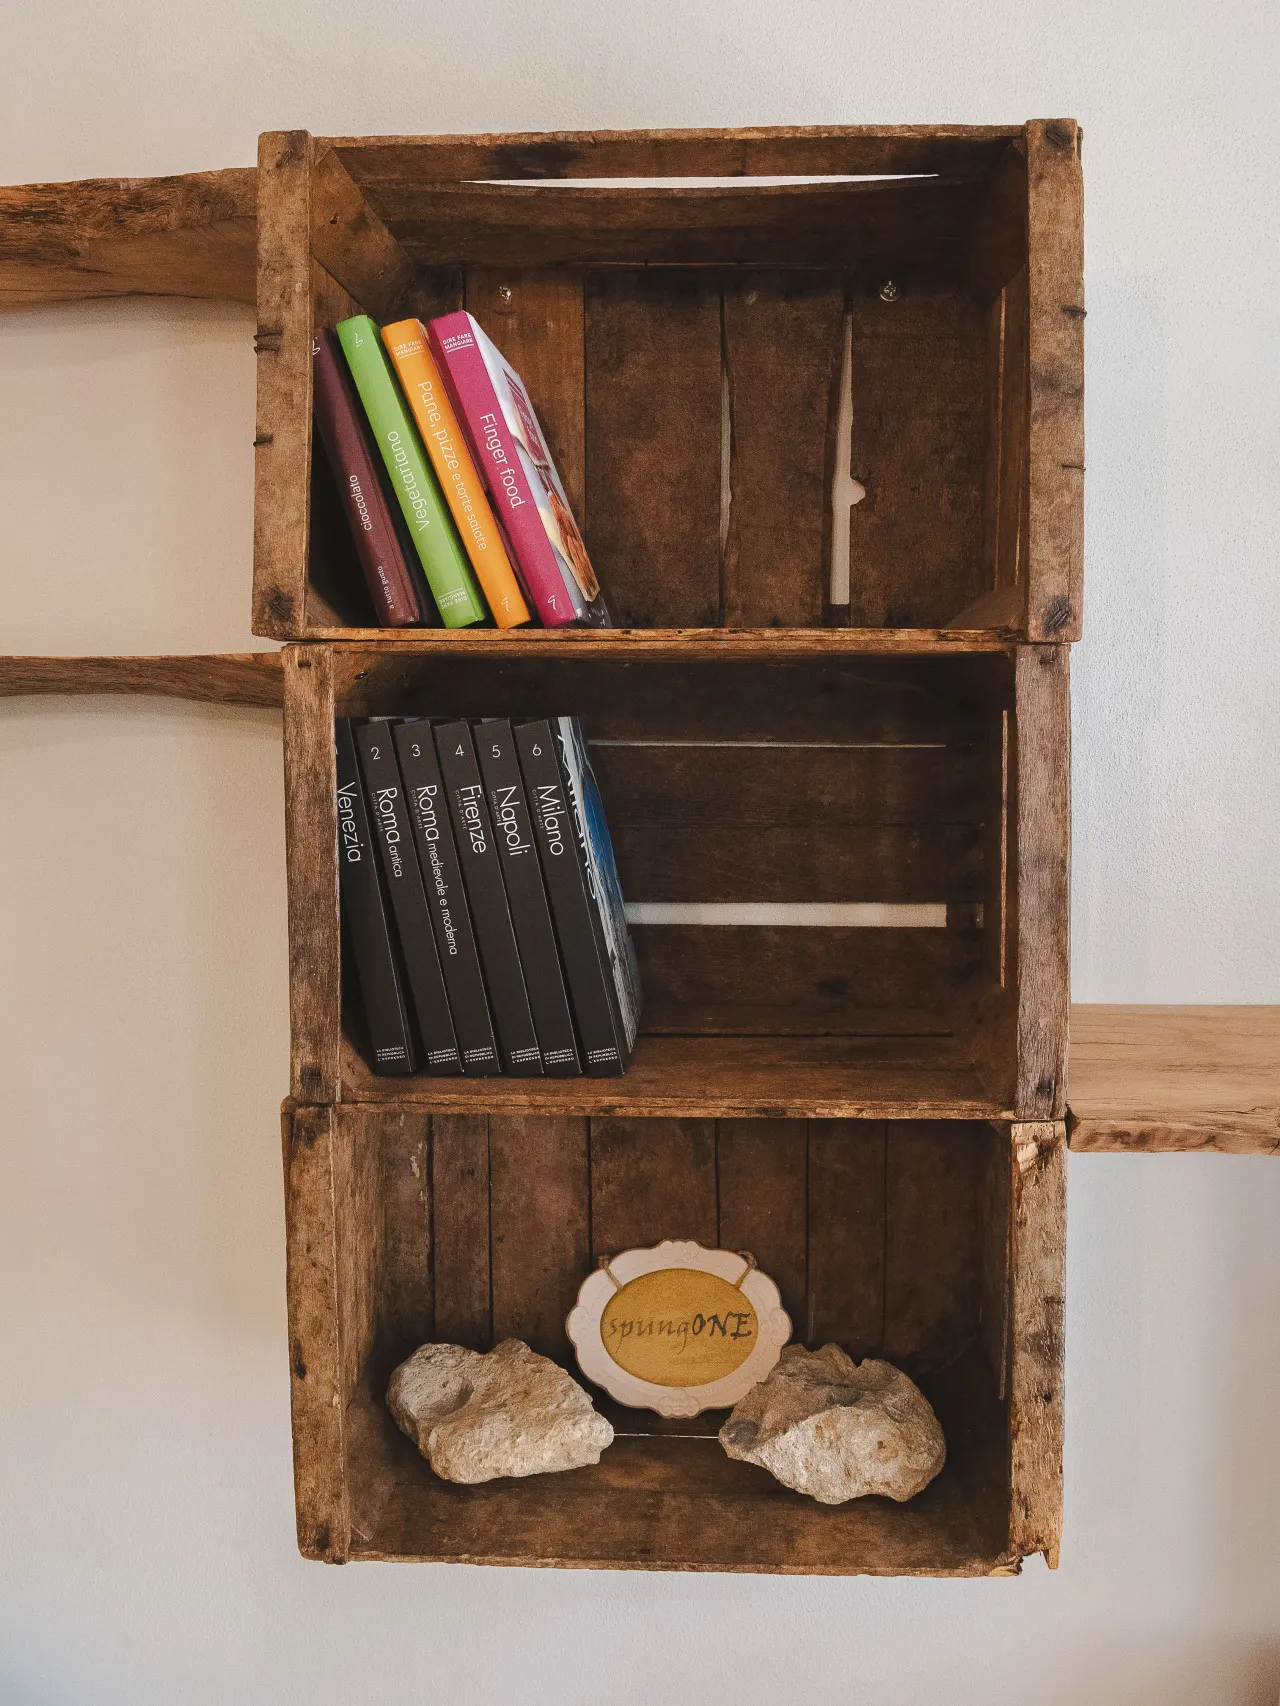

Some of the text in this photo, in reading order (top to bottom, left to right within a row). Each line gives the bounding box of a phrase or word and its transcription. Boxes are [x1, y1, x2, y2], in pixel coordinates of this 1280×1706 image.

[442, 332, 473, 346] DIRE FARE
[444, 337, 474, 350] MANGIARE
[387, 431, 431, 532] Vegetariano
[417, 381, 487, 551] Pane, pizze e torte salate
[479, 413, 526, 509] Finger food
[349, 475, 372, 531] cioccolato
[377, 565, 389, 585] gusto
[383, 586, 393, 604] tutto
[370, 746, 381, 760] 2
[411, 743, 421, 757] 3
[455, 744, 465, 757] 4
[492, 744, 501, 758] 5
[532, 743, 542, 757] 6
[337, 781, 364, 863] Venezia
[376, 787, 403, 878] Roma antica
[460, 784, 487, 853] Firenze
[496, 785, 531, 856] Napoli
[537, 785, 566, 855] Milano
[416, 784, 458, 956] Roma medievale e moderna
[605, 1310, 753, 1356] spungONE
